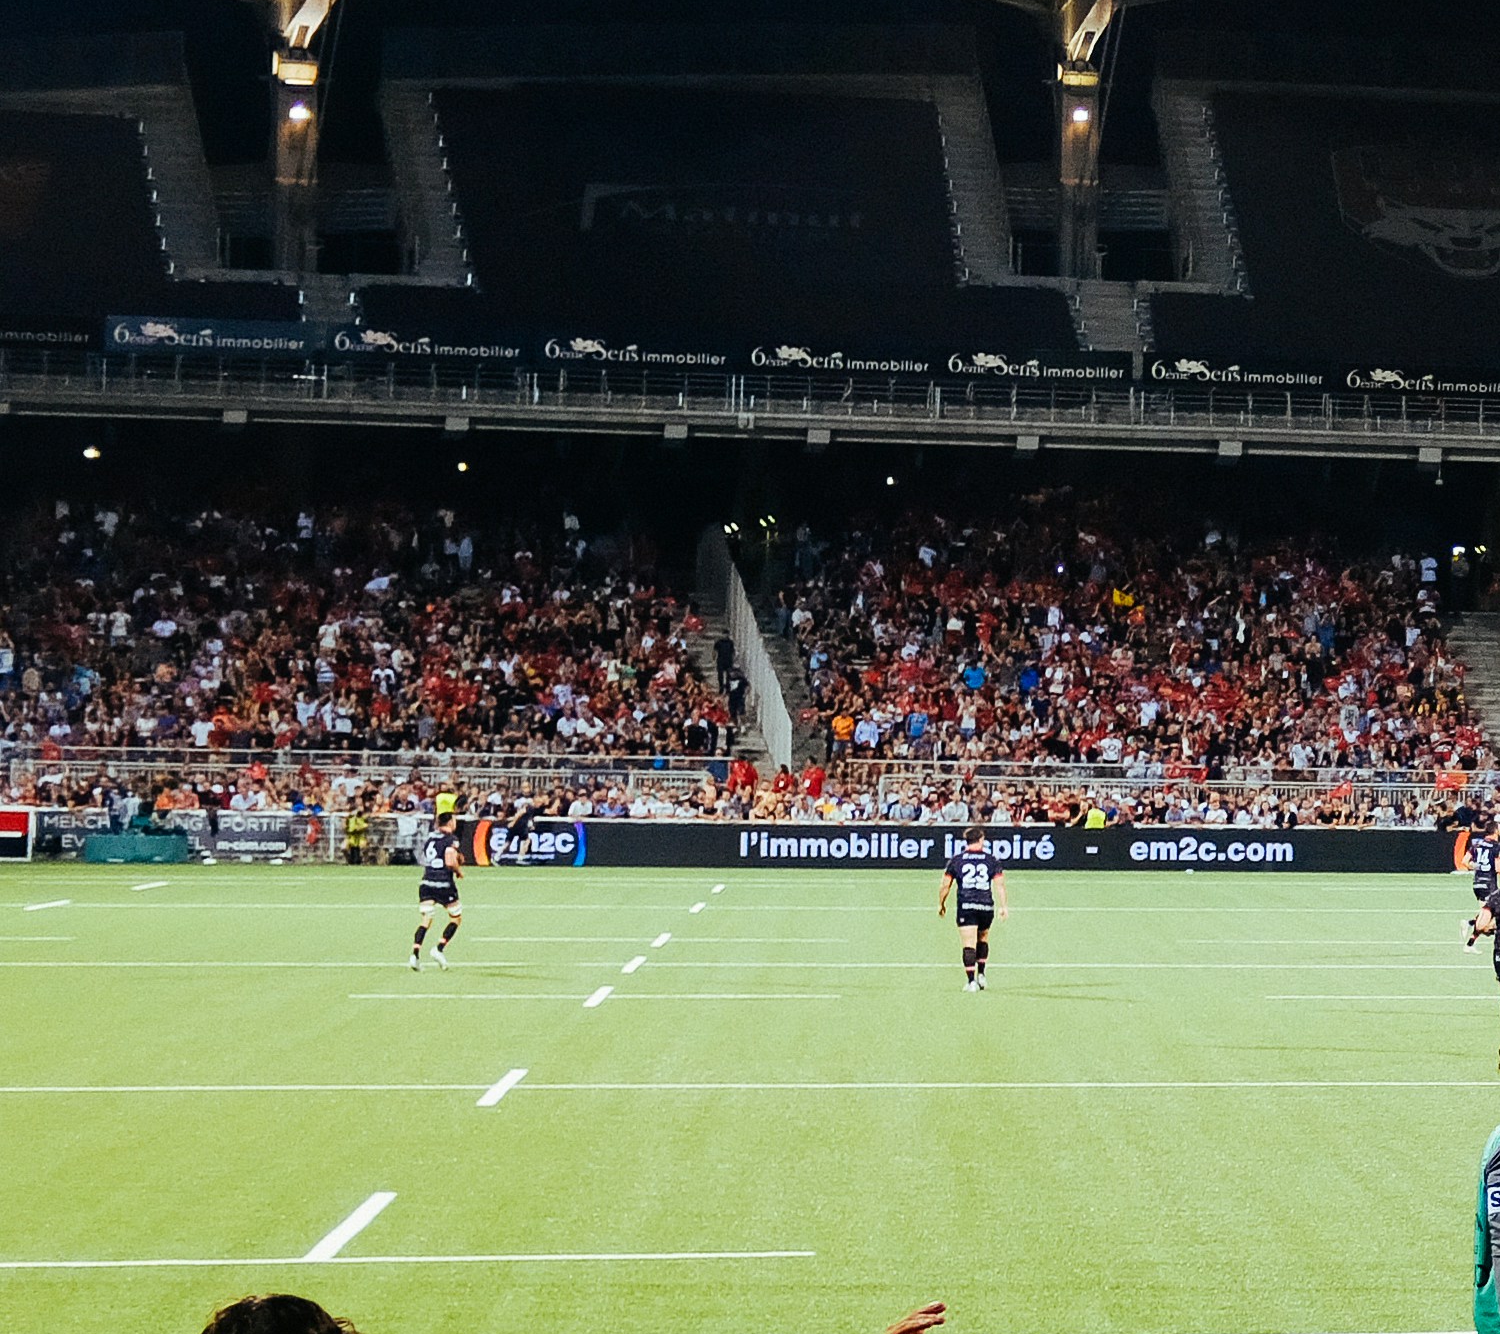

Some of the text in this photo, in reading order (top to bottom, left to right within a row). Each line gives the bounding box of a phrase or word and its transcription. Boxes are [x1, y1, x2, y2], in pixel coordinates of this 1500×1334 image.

[216, 336, 304, 350] immobilier
[434, 344, 520, 358] immobilier
[641, 351, 726, 366] immobilier
[846, 358, 929, 372] immobilier
[1043, 366, 1124, 379] immobilier
[1243, 371, 1323, 385] immobilier
[219, 816, 287, 831] PORTIF
[425, 841, 438, 859] 6
[740, 831, 934, 859] l'immobilier
[1130, 835, 1294, 862] em2c.com
[961, 864, 990, 884] 23
